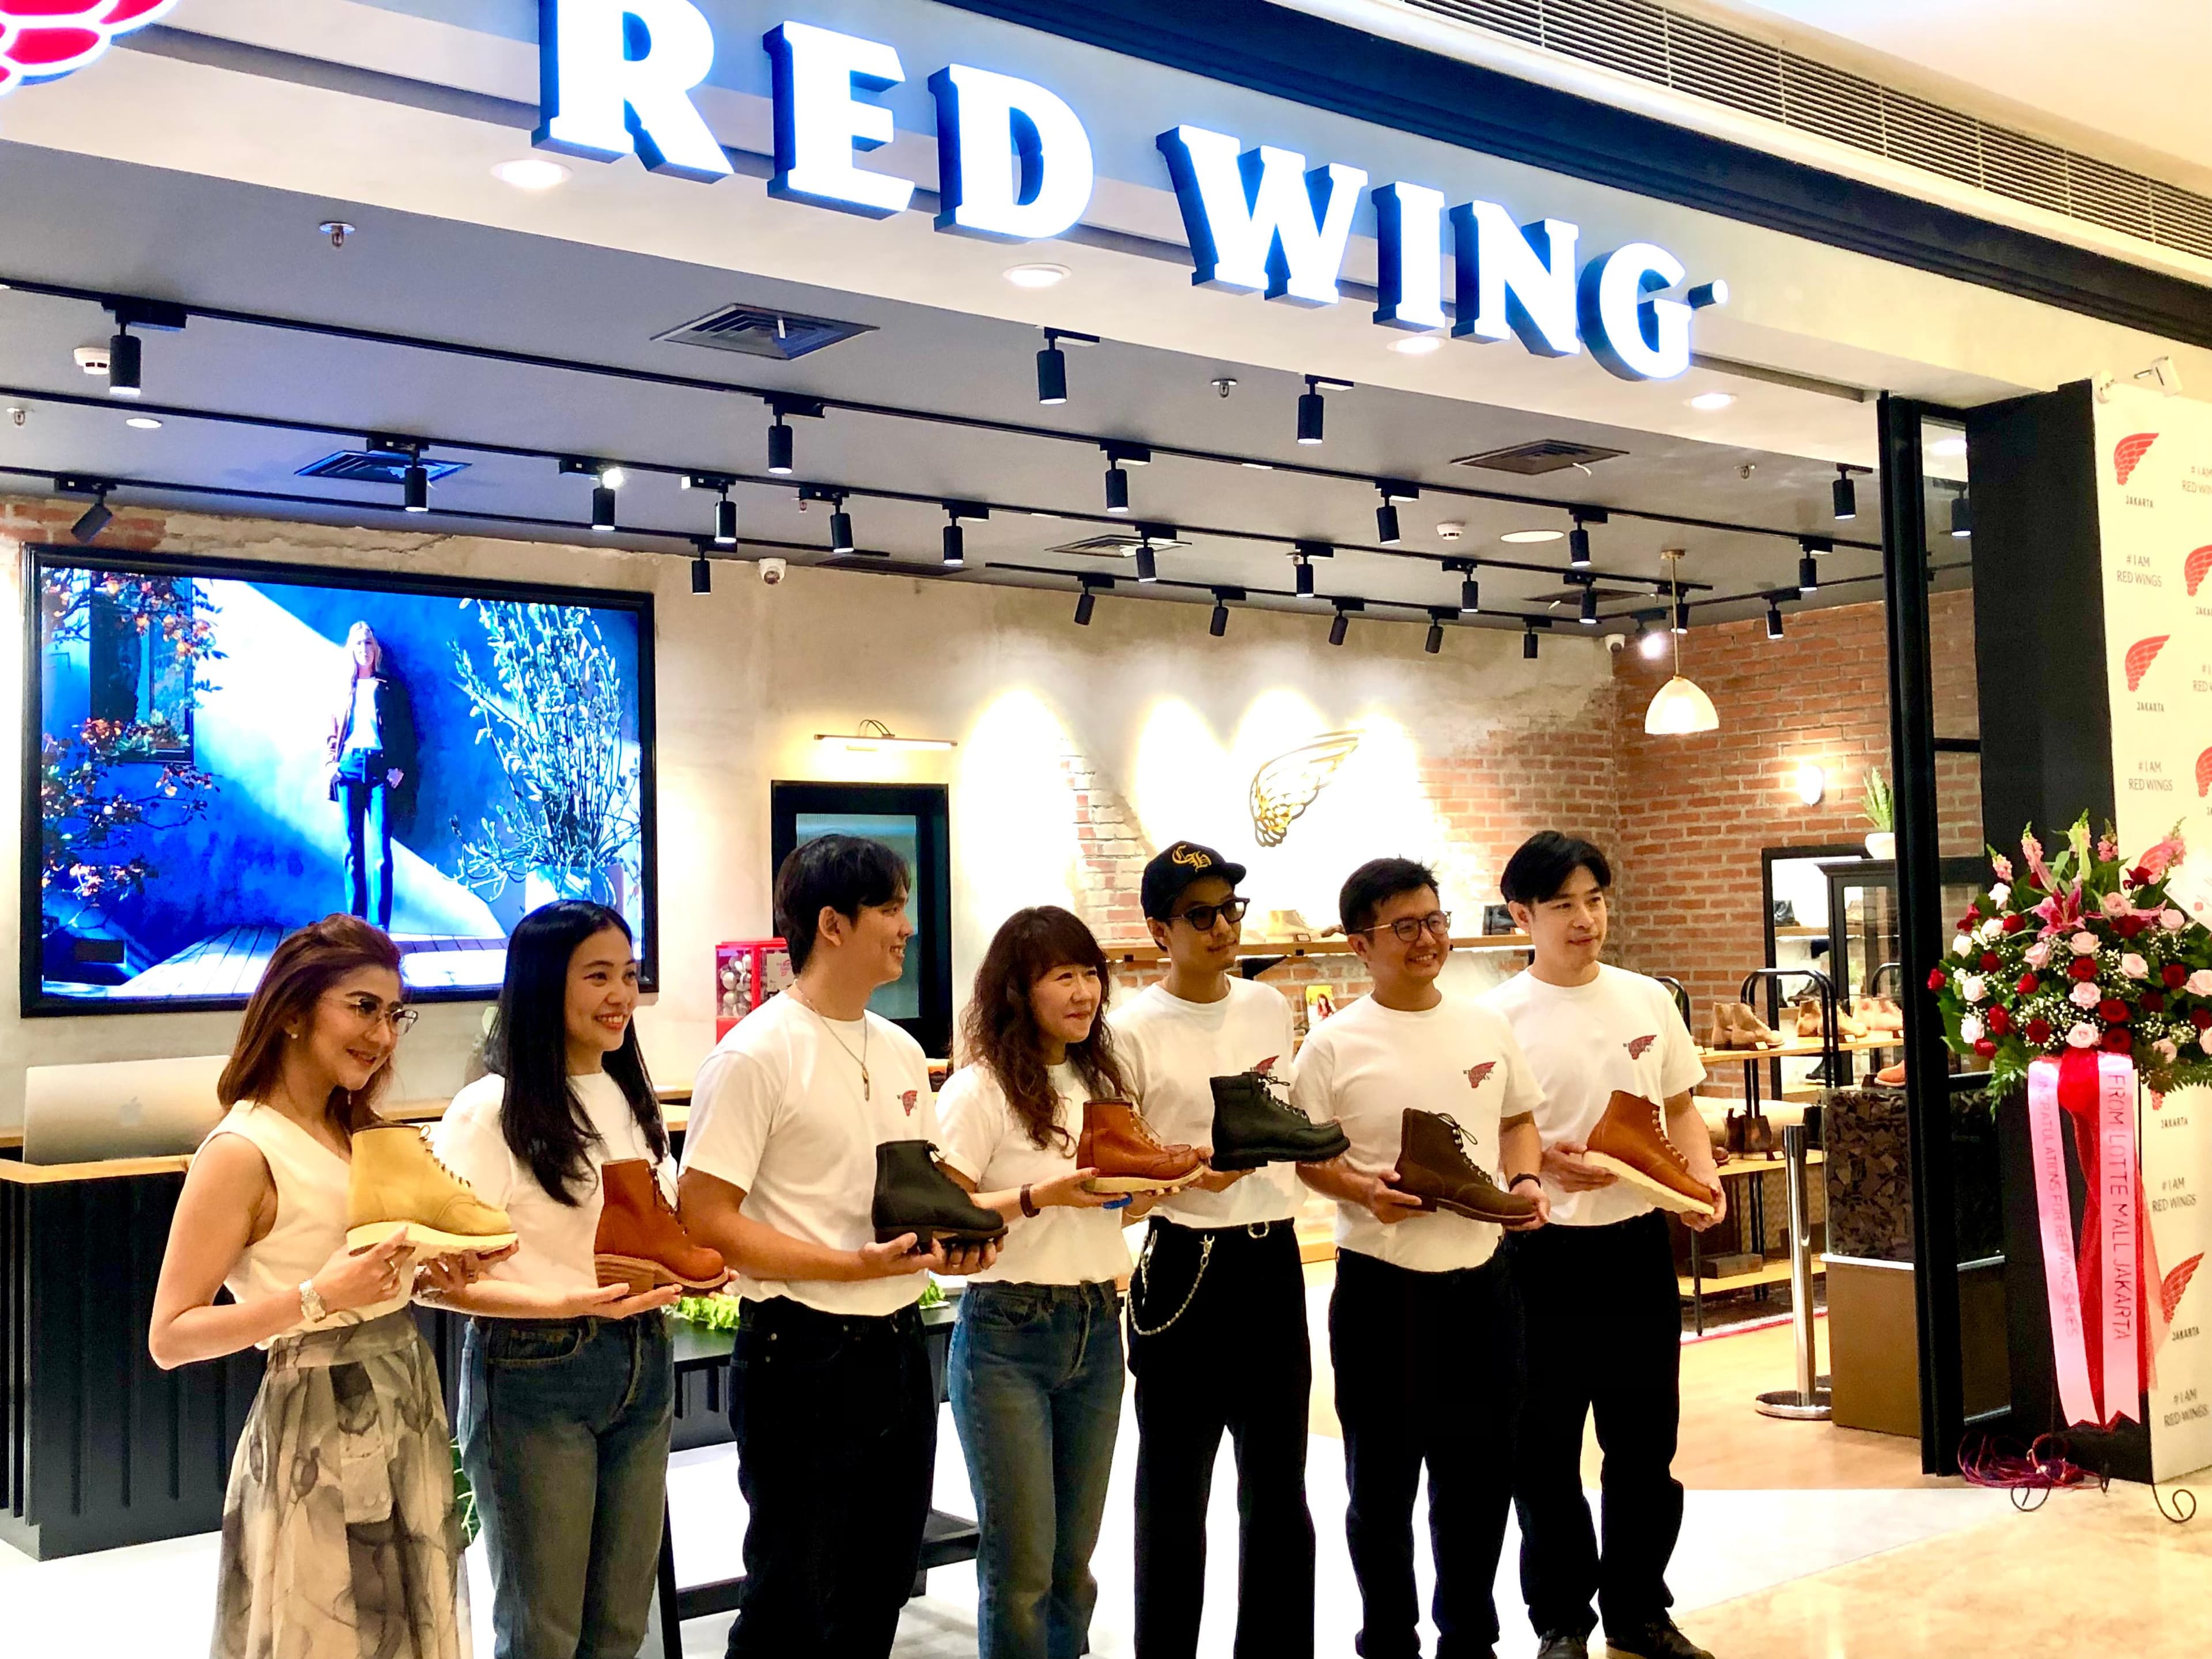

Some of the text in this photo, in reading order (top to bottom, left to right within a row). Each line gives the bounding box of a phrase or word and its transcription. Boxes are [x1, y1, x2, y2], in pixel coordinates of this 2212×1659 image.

[544, 0, 1692, 380] RED WING
[2182, 480, 2196, 493] RED
[2126, 495, 2154, 508] JAKARTA
[2117, 570, 2162, 588] RED WINGS
[2193, 680, 2208, 692] RED
[2137, 701, 2165, 713] JAKARTA
[2128, 778, 2173, 791] RED WINGS
[2161, 1116, 2188, 1129] JAKARTA
[2108, 1135, 2128, 1195] LOTTE
[2152, 1193, 2197, 1213] RED WINGS
[2112, 1203, 2130, 1253] MALL
[2112, 1259, 2131, 1340] JAKARTA
[2172, 1325, 2199, 1342] JAKARTA
[2164, 1404, 2208, 1428] RED WINGS
